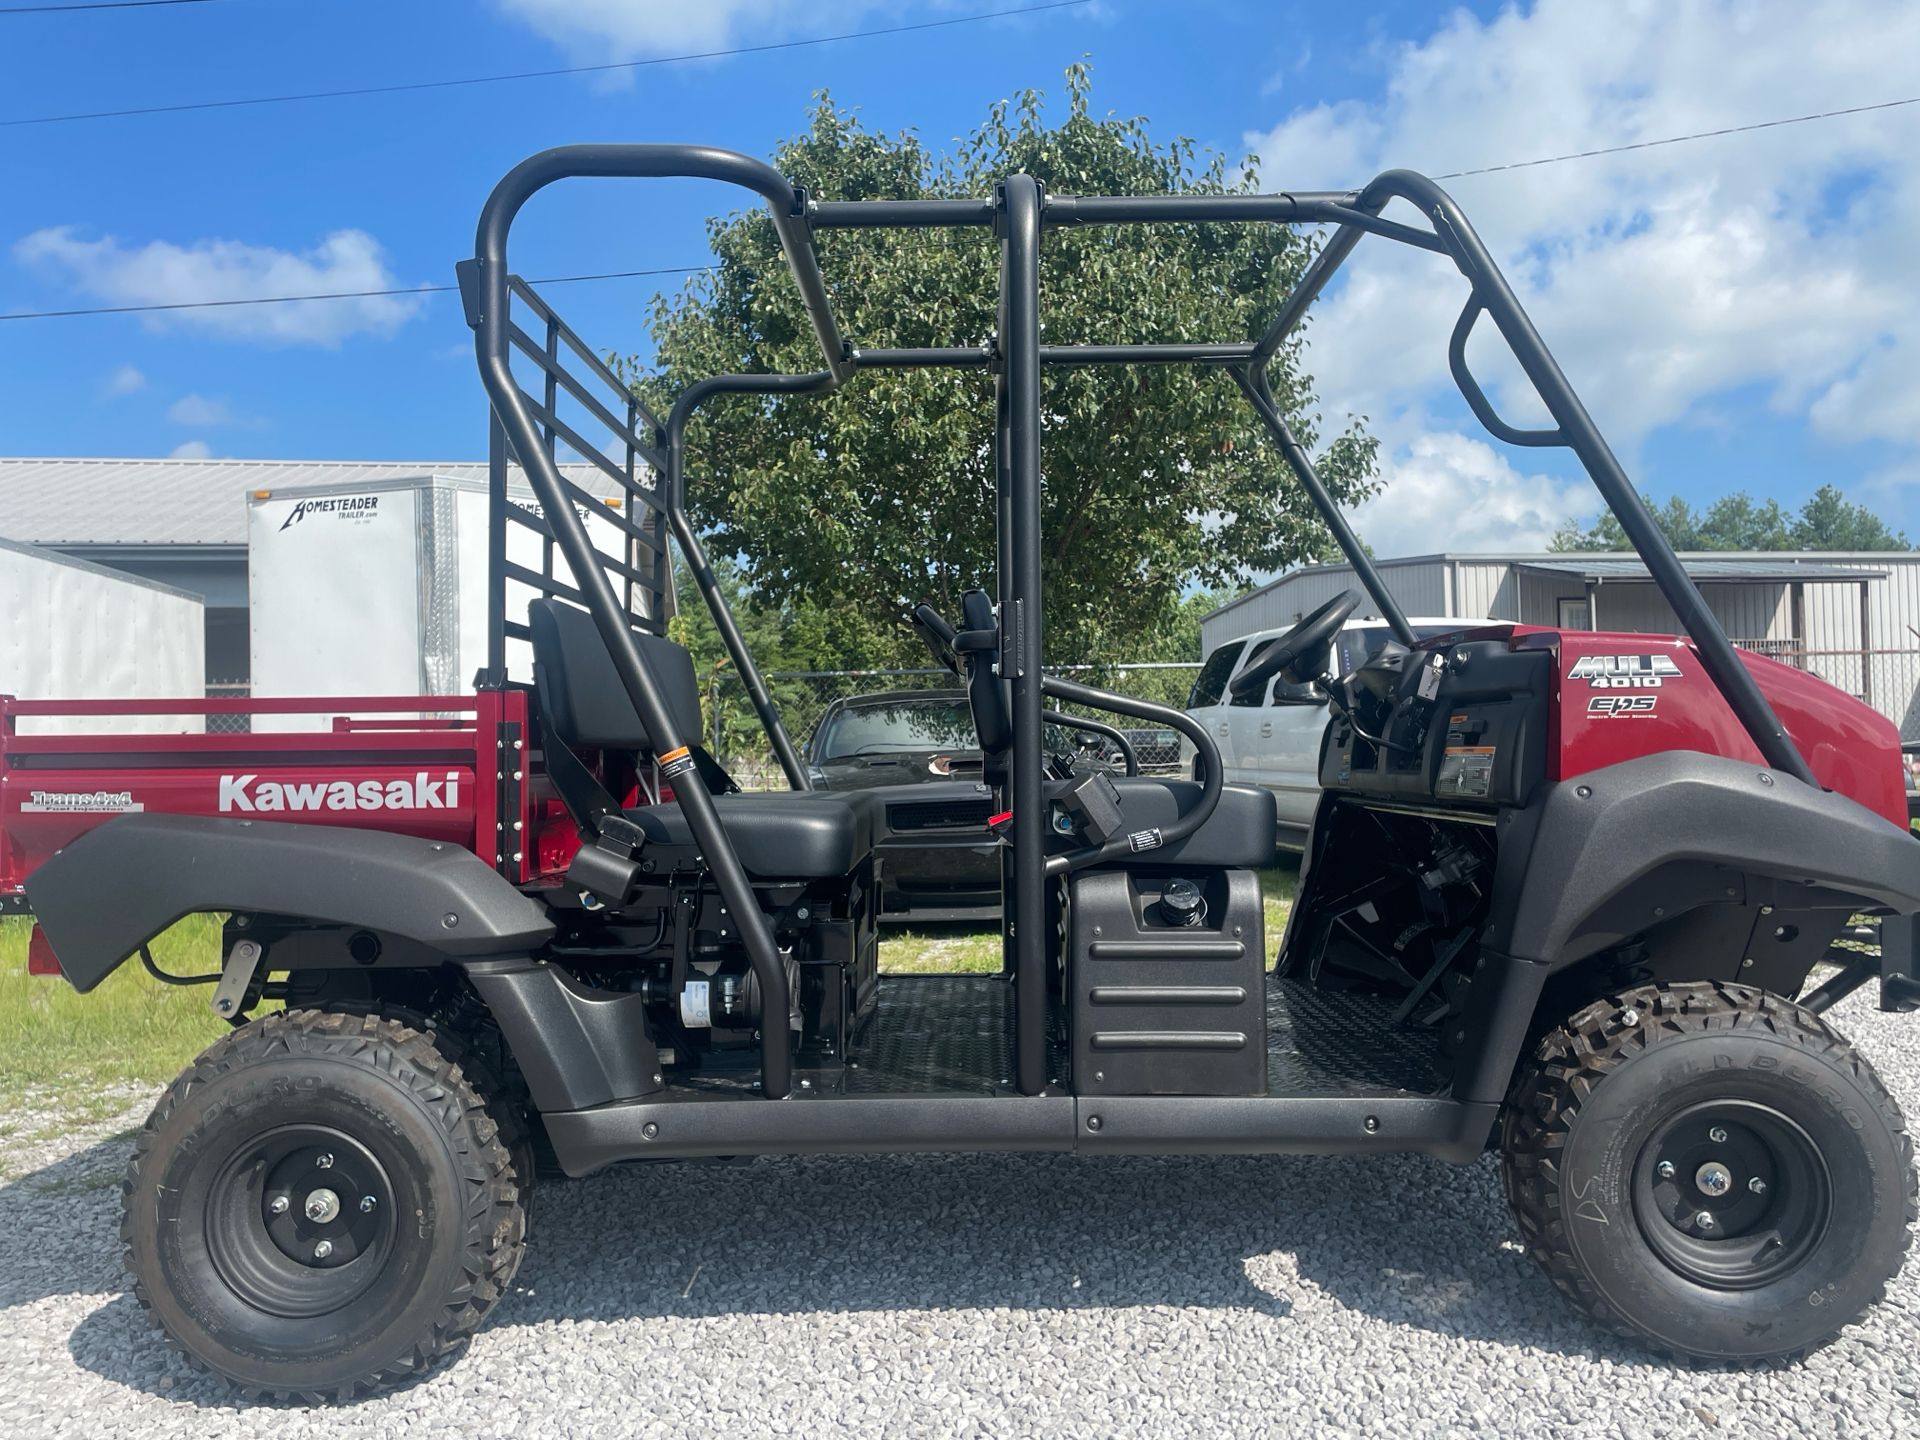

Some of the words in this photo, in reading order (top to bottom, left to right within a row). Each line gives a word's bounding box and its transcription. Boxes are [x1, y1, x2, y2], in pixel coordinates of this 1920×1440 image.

[279, 496, 379, 532] HOMESTEADER
[1567, 655, 1684, 680] MULE
[1590, 677, 1662, 689] 4010
[30, 791, 133, 807] Trans4x4
[218, 771, 460, 812] Kawasaki
[1747, 1055, 1864, 1131] DURO
